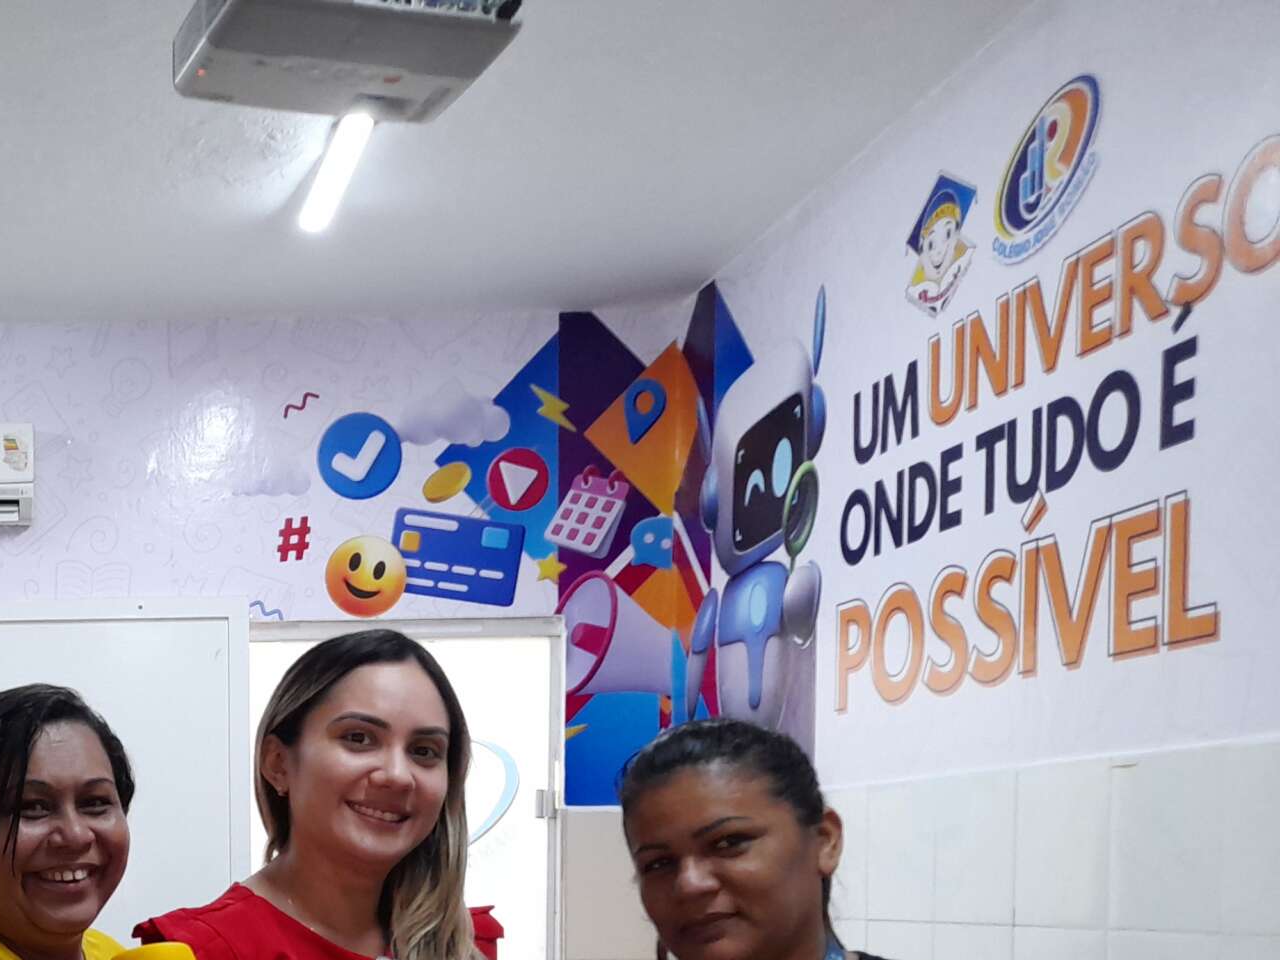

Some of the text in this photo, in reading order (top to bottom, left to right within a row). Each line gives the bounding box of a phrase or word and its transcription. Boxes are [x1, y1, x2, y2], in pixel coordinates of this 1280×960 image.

[852, 132, 1280, 464] UM UNIVERSO
[839, 301, 1199, 566] ONDE TUDO É
[834, 489, 1220, 715] POSSÍVEL
